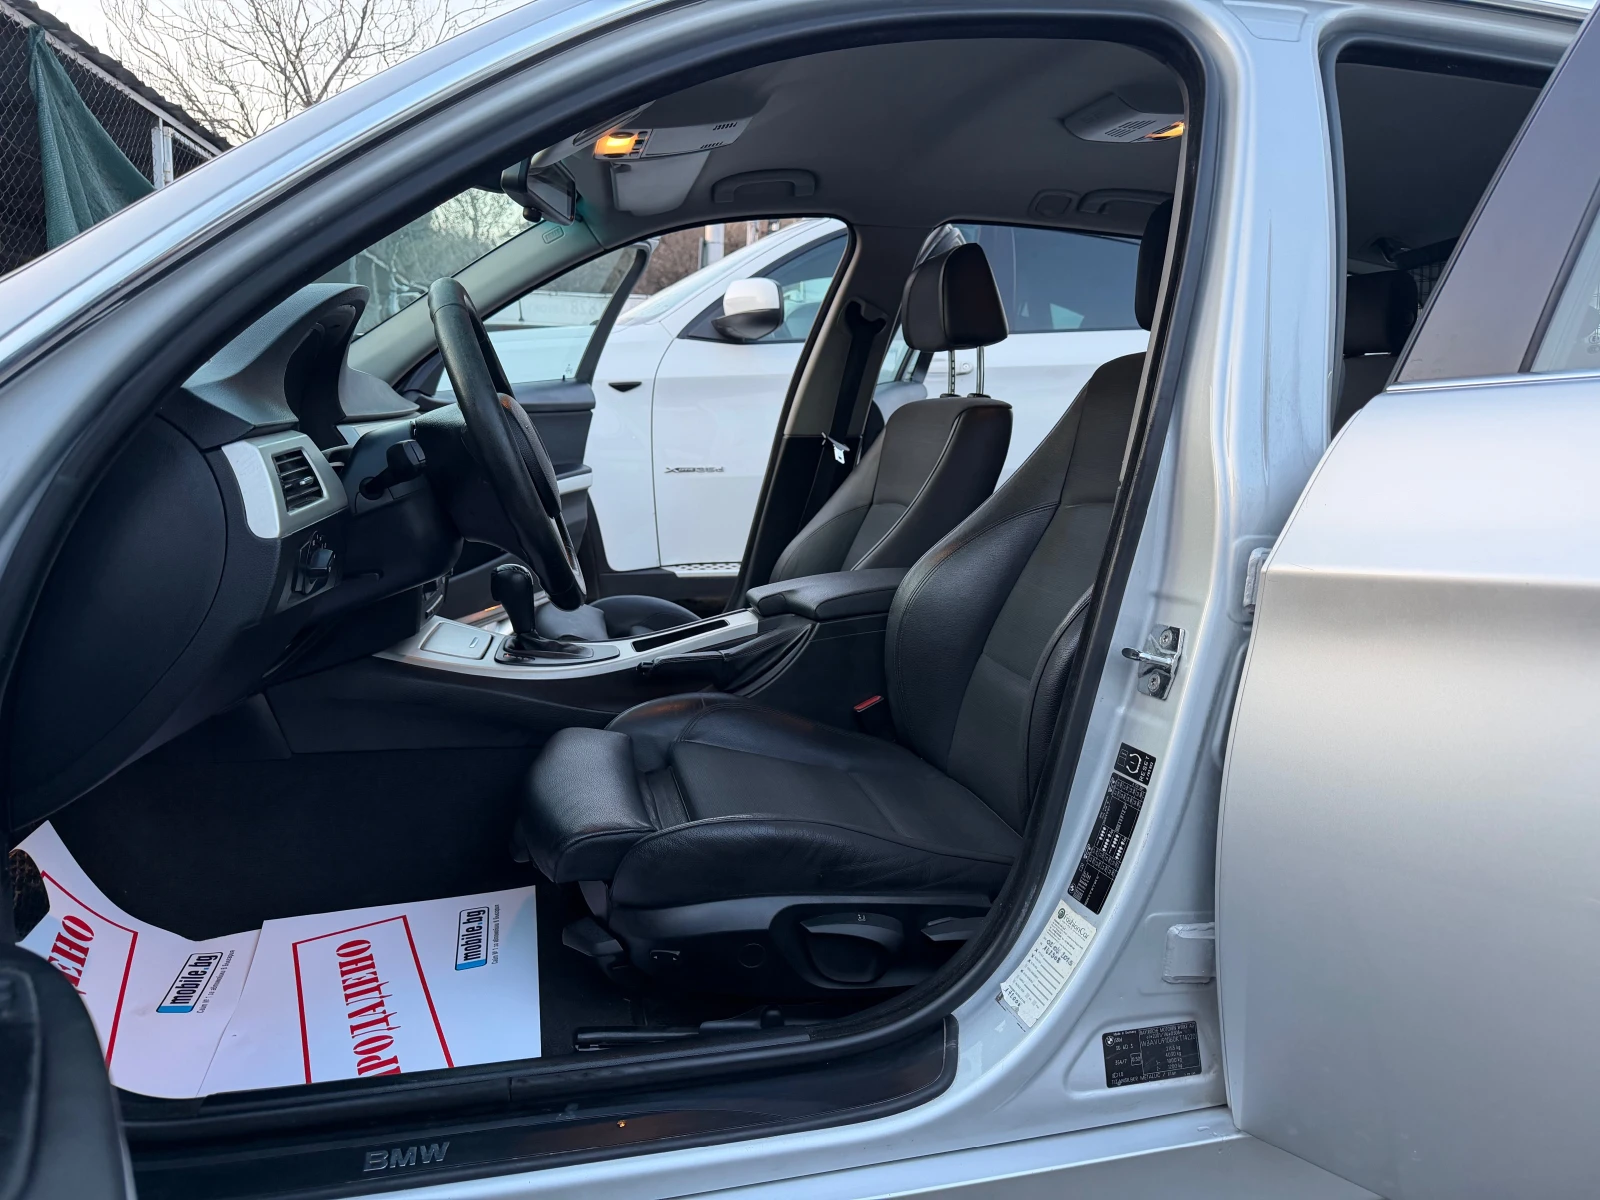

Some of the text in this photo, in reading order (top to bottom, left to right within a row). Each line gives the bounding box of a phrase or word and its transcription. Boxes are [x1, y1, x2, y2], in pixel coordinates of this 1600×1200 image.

[1139, 755, 1150, 782] RESET
[461, 909, 486, 962] mobile.bg
[170, 955, 219, 1004] mobile.bg
[363, 1142, 450, 1172] BMW
